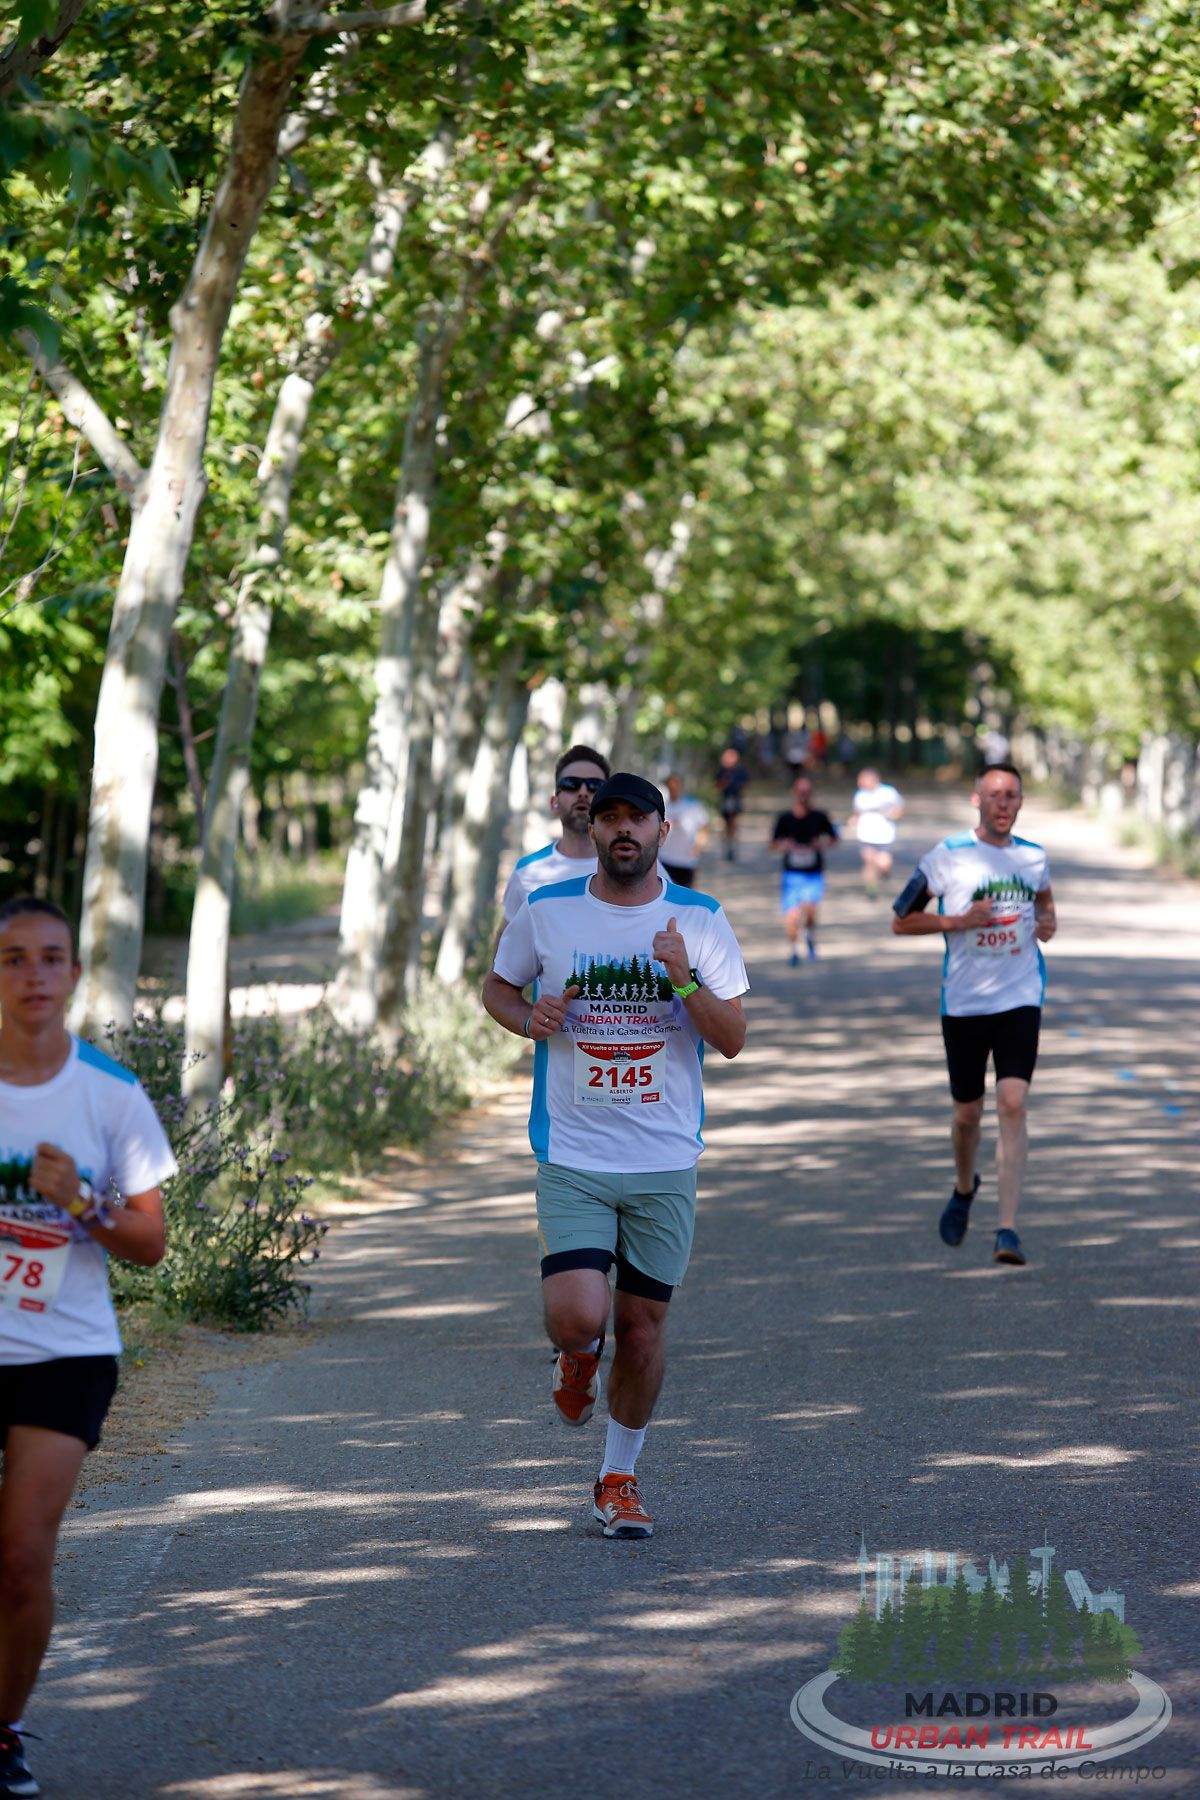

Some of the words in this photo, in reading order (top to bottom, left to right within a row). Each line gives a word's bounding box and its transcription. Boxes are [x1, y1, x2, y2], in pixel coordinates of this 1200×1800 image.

[977, 930, 1017, 947] 2095
[590, 1003, 648, 1014] MADRID
[579, 1014, 621, 1025] URBAN
[626, 1015, 660, 1025] TRAIL
[571, 1024, 597, 1035] Vuelta
[599, 1028, 605, 1036] a
[606, 1027, 615, 1036] la
[617, 1027, 639, 1036] Casa
[641, 1026, 652, 1035] de
[588, 1065, 653, 1088] 2145
